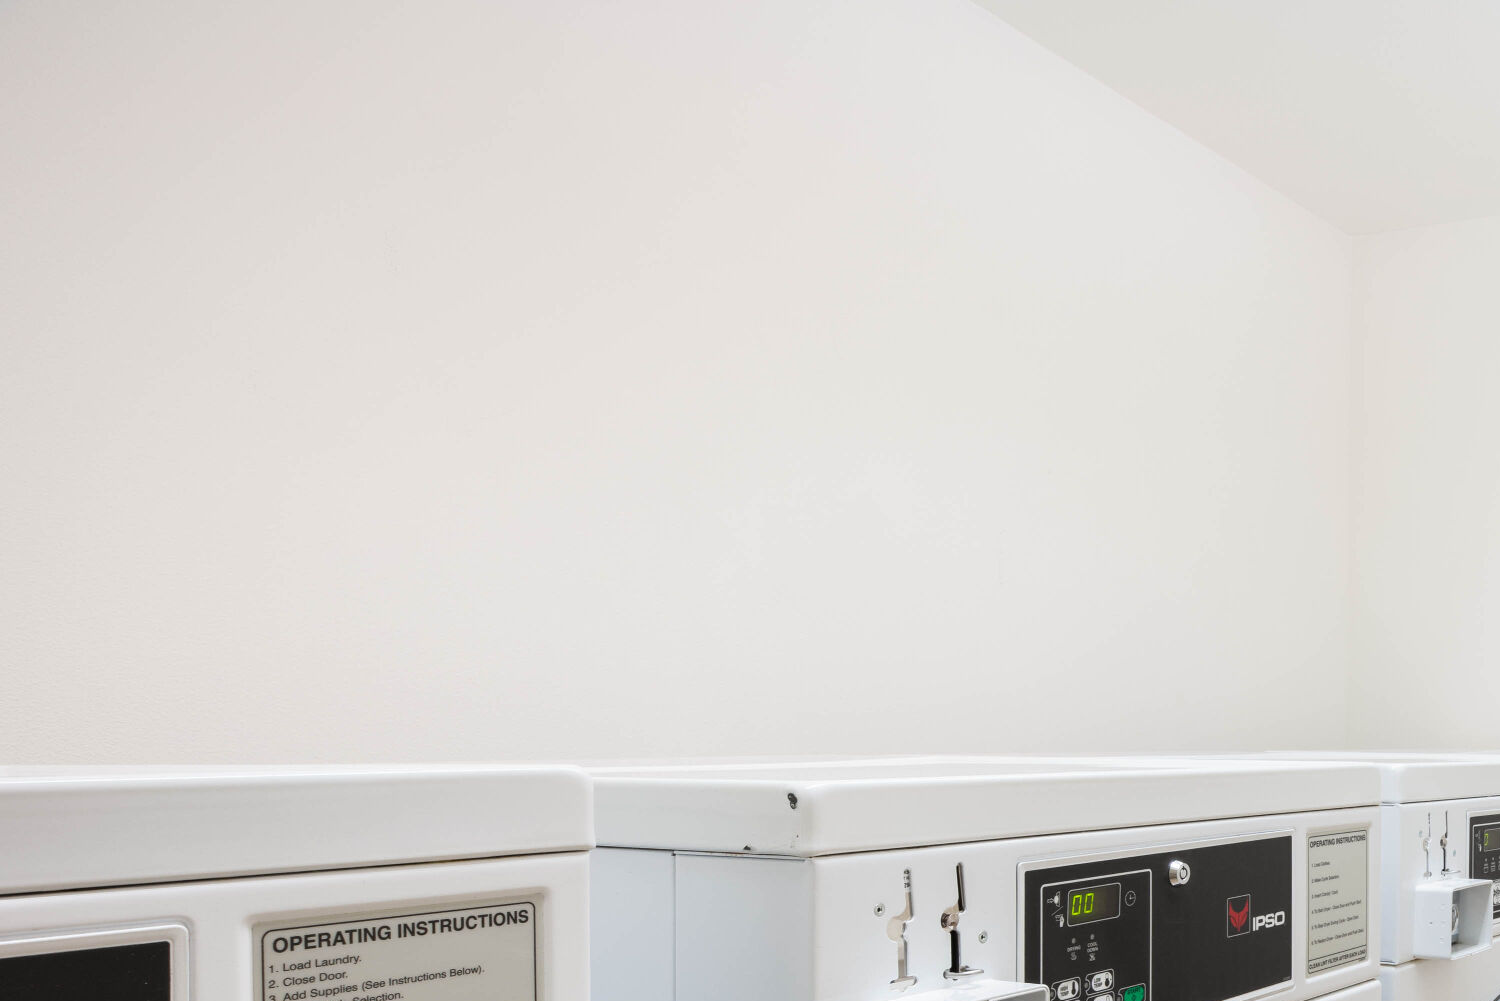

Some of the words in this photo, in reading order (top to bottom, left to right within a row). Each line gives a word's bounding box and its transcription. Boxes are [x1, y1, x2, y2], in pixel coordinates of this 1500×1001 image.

[1072, 892, 1094, 916] 00
[272, 925, 392, 953] OPERATING
[397, 910, 529, 938] INSTRUCTIONS
[1252, 910, 1286, 931] IPSO
[268, 965, 279, 974] 1.
[282, 960, 312, 972] Load
[315, 954, 362, 968] Laundry.
[268, 980, 279, 988] 2.
[282, 976, 316, 986] Close
[320, 971, 348, 982] Door.
[283, 990, 306, 1001] Add
[310, 984, 358, 998] Supplies
[362, 980, 386, 992] (See
[388, 971, 446, 986] Instructions
[450, 965, 485, 978] Below).
